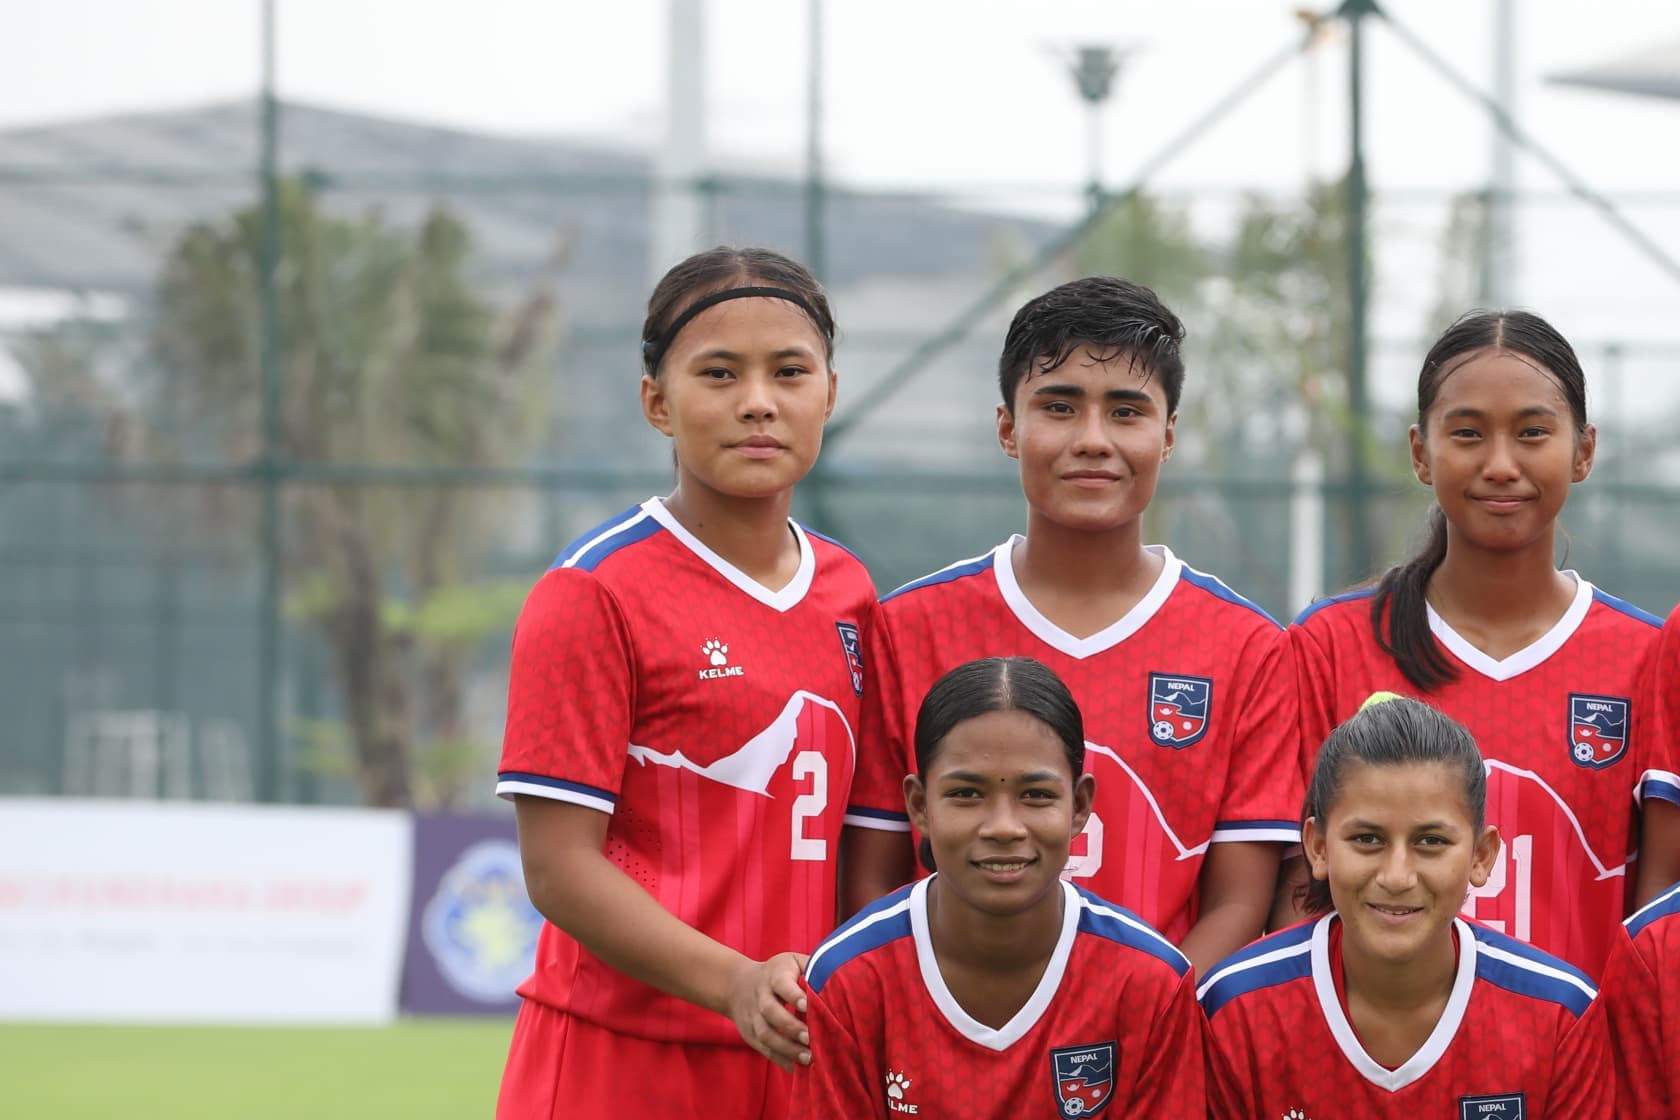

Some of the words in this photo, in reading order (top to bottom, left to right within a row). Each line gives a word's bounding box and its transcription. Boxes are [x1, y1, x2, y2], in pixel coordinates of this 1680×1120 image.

[699, 666, 744, 680] KELME
[1168, 681, 1195, 692] NEPAL
[1586, 702, 1613, 712] NEPAL
[790, 750, 828, 860] 2
[1070, 1052, 1098, 1064] NEPAL
[1478, 1103, 1506, 1112] NEPAL
